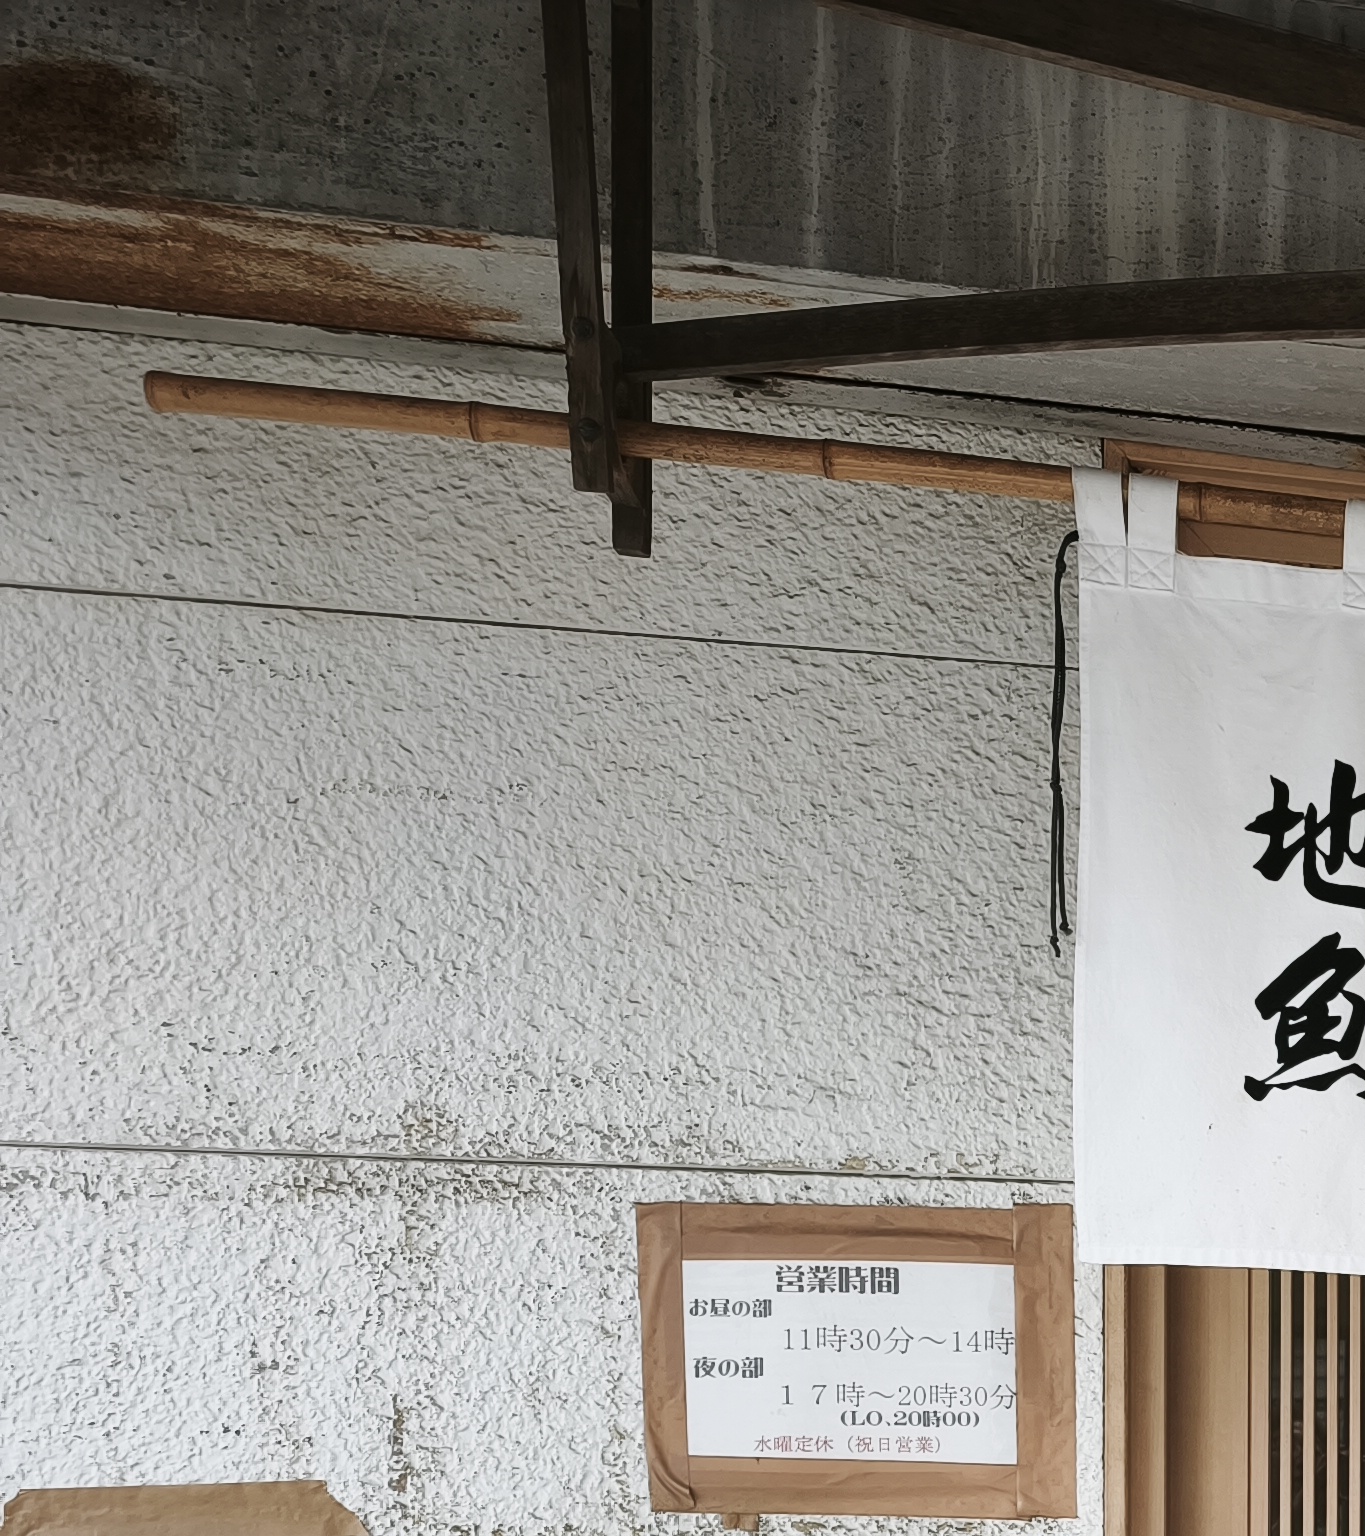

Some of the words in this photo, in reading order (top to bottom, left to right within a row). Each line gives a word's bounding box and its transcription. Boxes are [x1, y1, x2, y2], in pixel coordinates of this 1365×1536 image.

[775, 1265, 900, 1295] 営業時間
[689, 1298, 772, 1318] お昼の部
[783, 1324, 1015, 1356] 11時30分～14時
[693, 1357, 764, 1379] 夜の部
